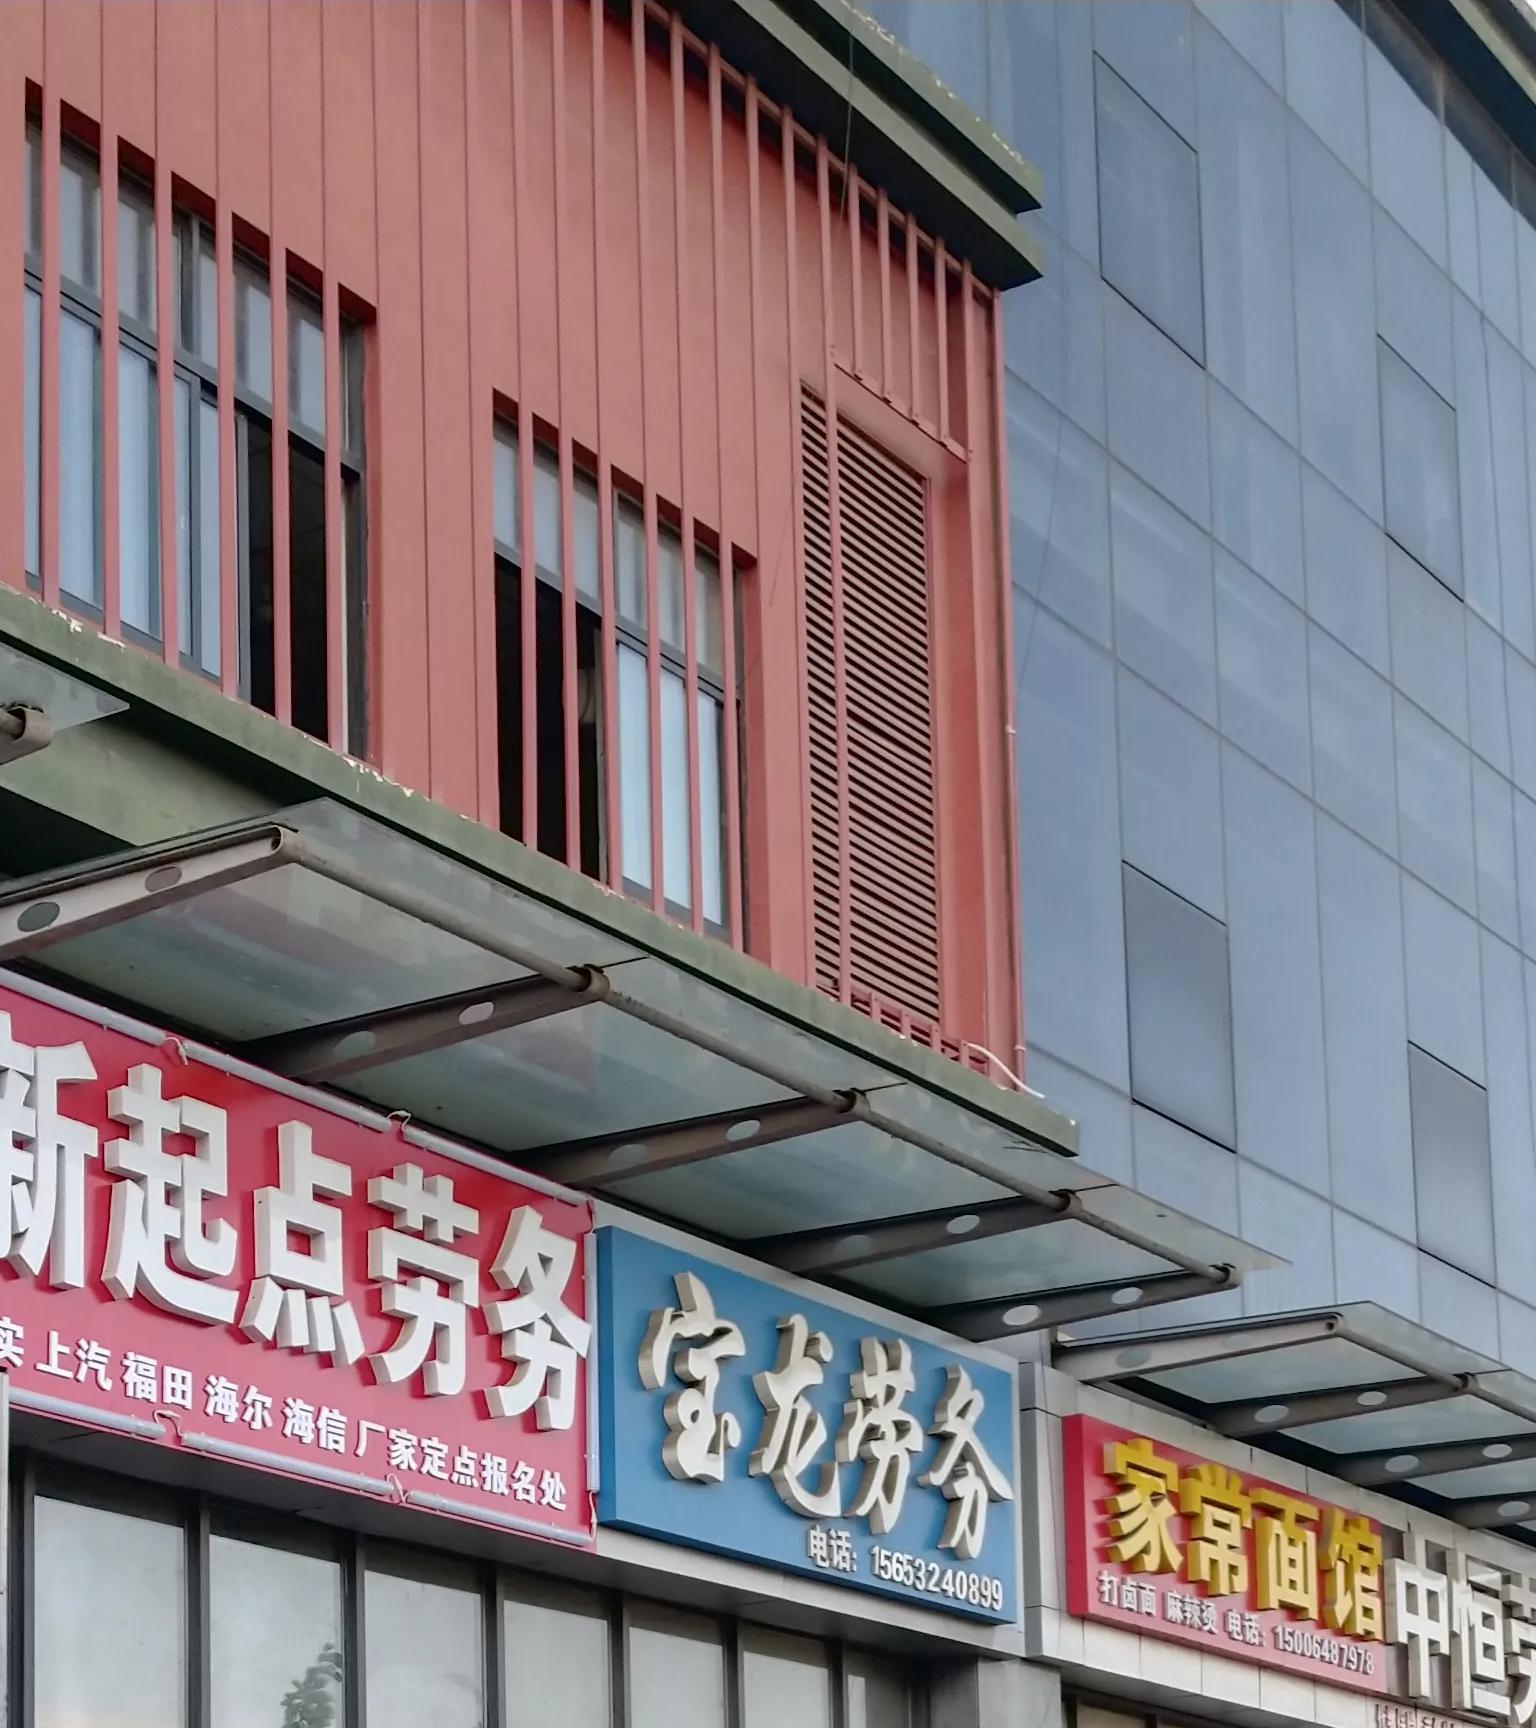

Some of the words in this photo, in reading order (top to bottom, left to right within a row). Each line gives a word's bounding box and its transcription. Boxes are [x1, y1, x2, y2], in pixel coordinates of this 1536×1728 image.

[36, 1330, 113, 1393] 上汽
[121, 1351, 194, 1412] 福田
[204, 1373, 273, 1432] 海尔
[282, 1396, 347, 1455] 海信
[356, 1419, 568, 1512] 厂家定点报名处
[637, 1270, 1014, 1561] 宝龙劳务
[870, 1544, 1004, 1612] 15653240899
[1097, 1570, 1157, 1617] 打卤面
[1164, 1590, 1219, 1635] 麻辣烫
[1100, 1437, 1384, 1642] 家常面馆
